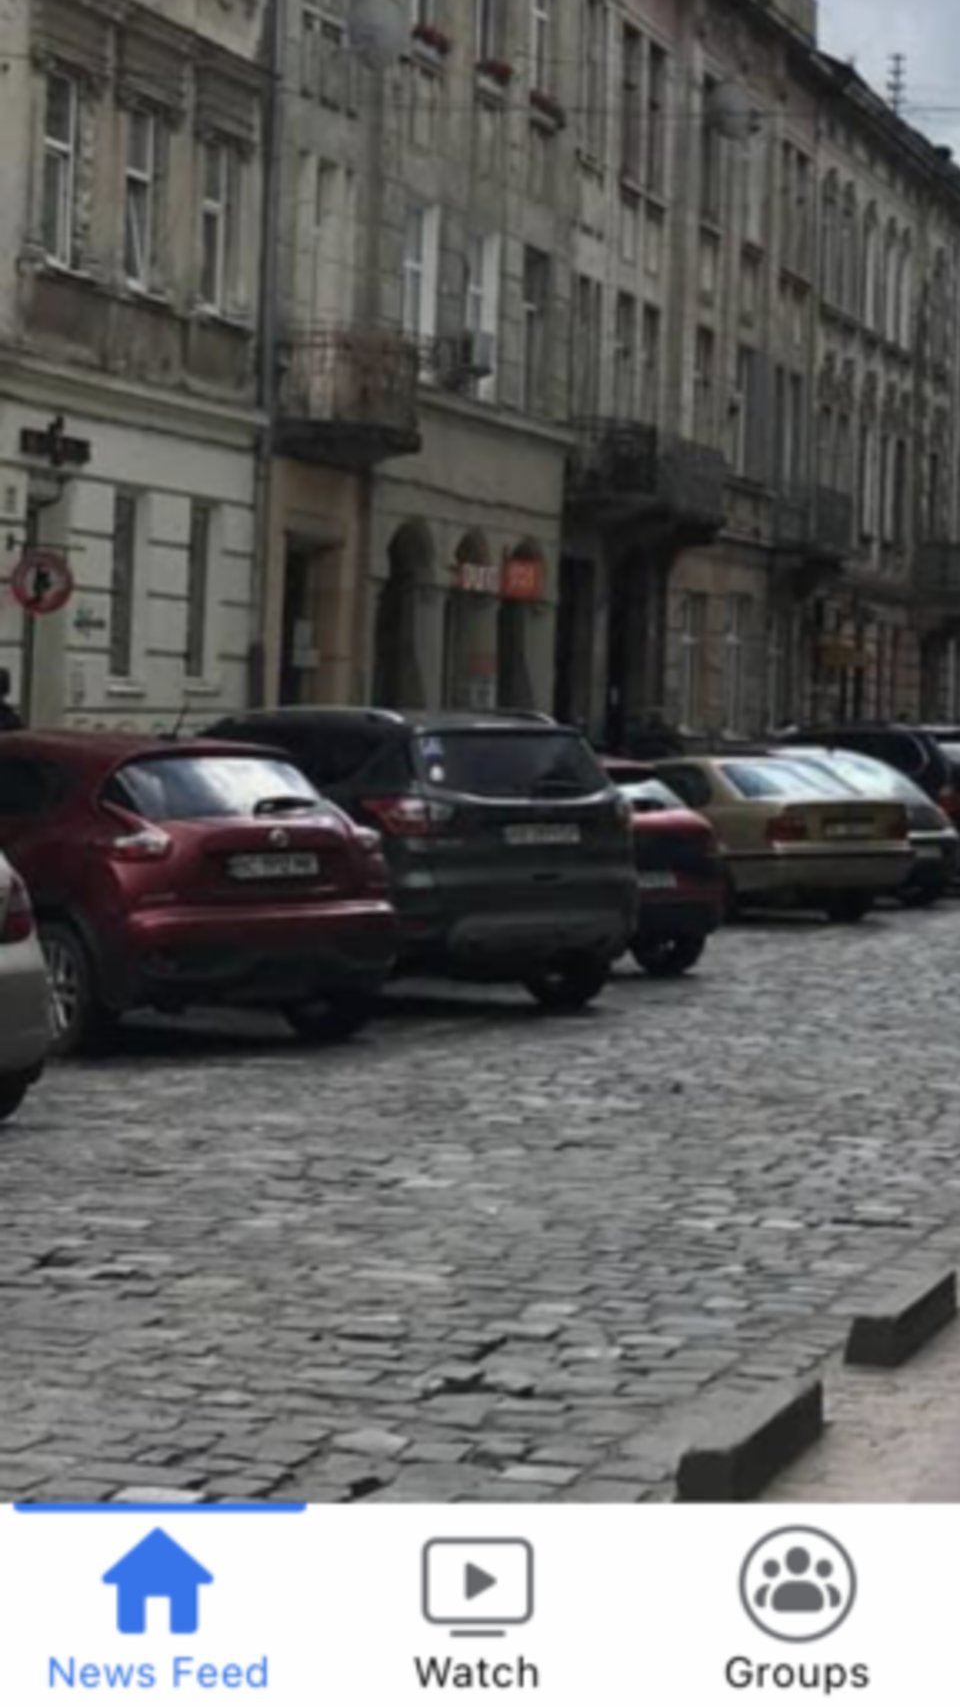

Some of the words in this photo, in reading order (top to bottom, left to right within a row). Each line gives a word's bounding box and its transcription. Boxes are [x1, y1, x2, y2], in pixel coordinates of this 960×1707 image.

[48, 1656, 157, 1689] News
[172, 1655, 269, 1689] Feed
[413, 1654, 540, 1690] Watch
[724, 1654, 871, 1696] Groups
